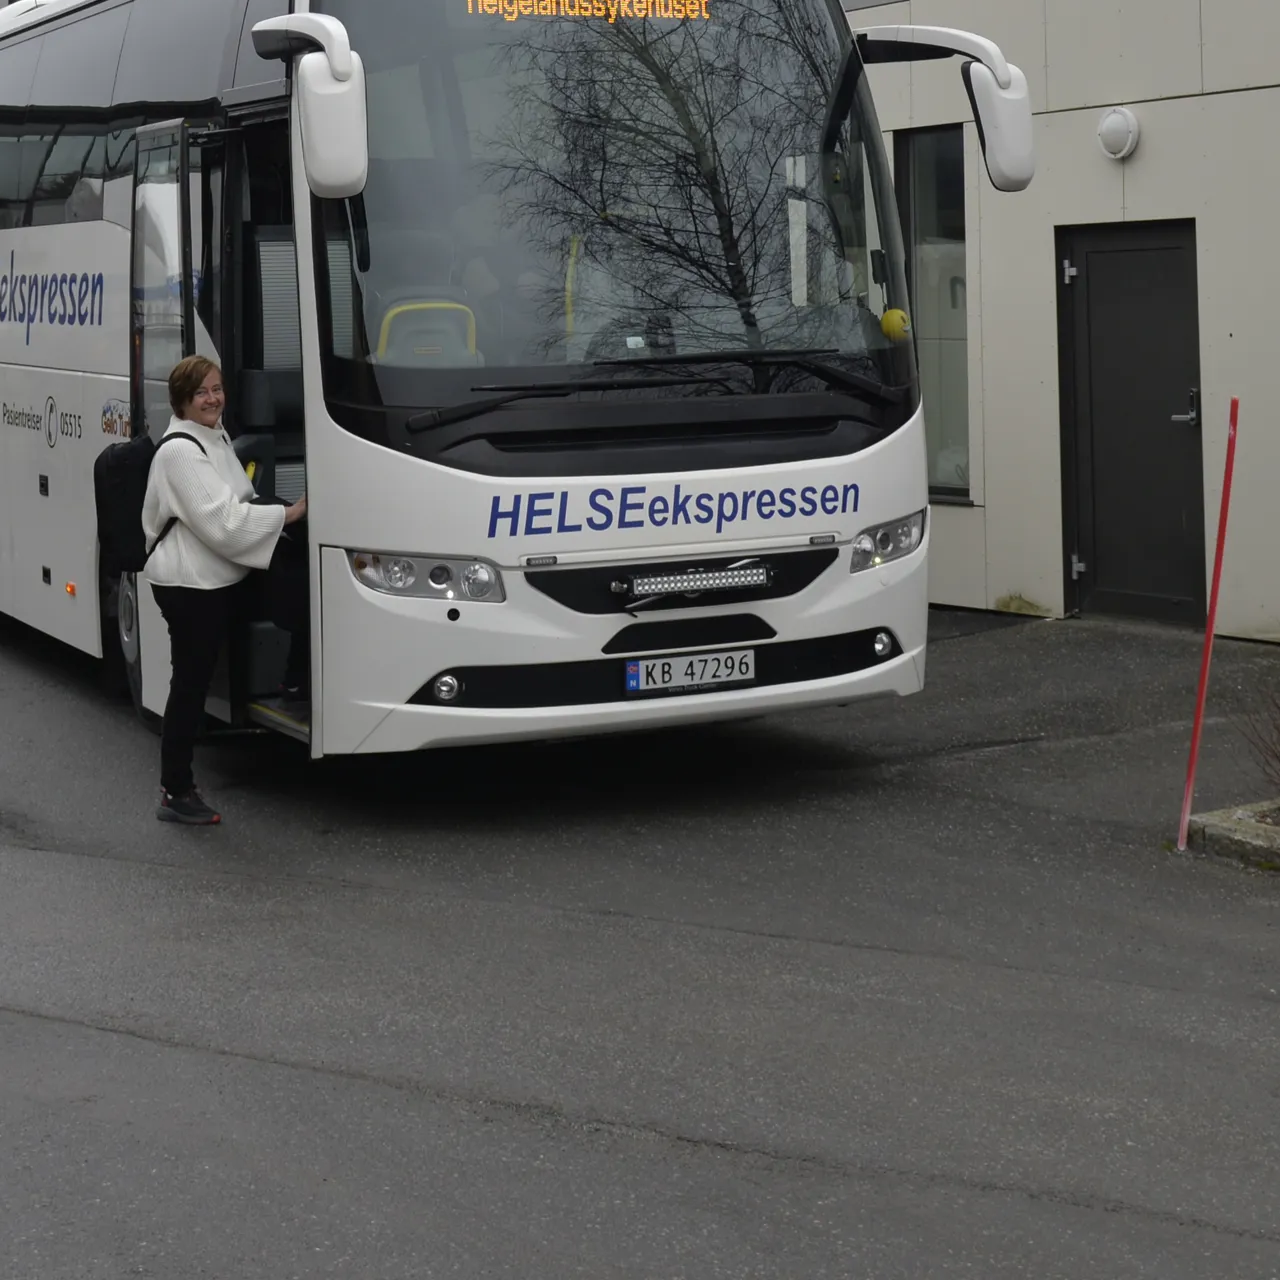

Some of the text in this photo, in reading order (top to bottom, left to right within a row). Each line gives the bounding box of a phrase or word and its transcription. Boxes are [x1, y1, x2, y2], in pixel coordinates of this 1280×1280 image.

[2, 402, 82, 439] Pasientreiser 05515
[486, 482, 860, 539] HELSEekspressen
[645, 654, 750, 686] KB 47296
